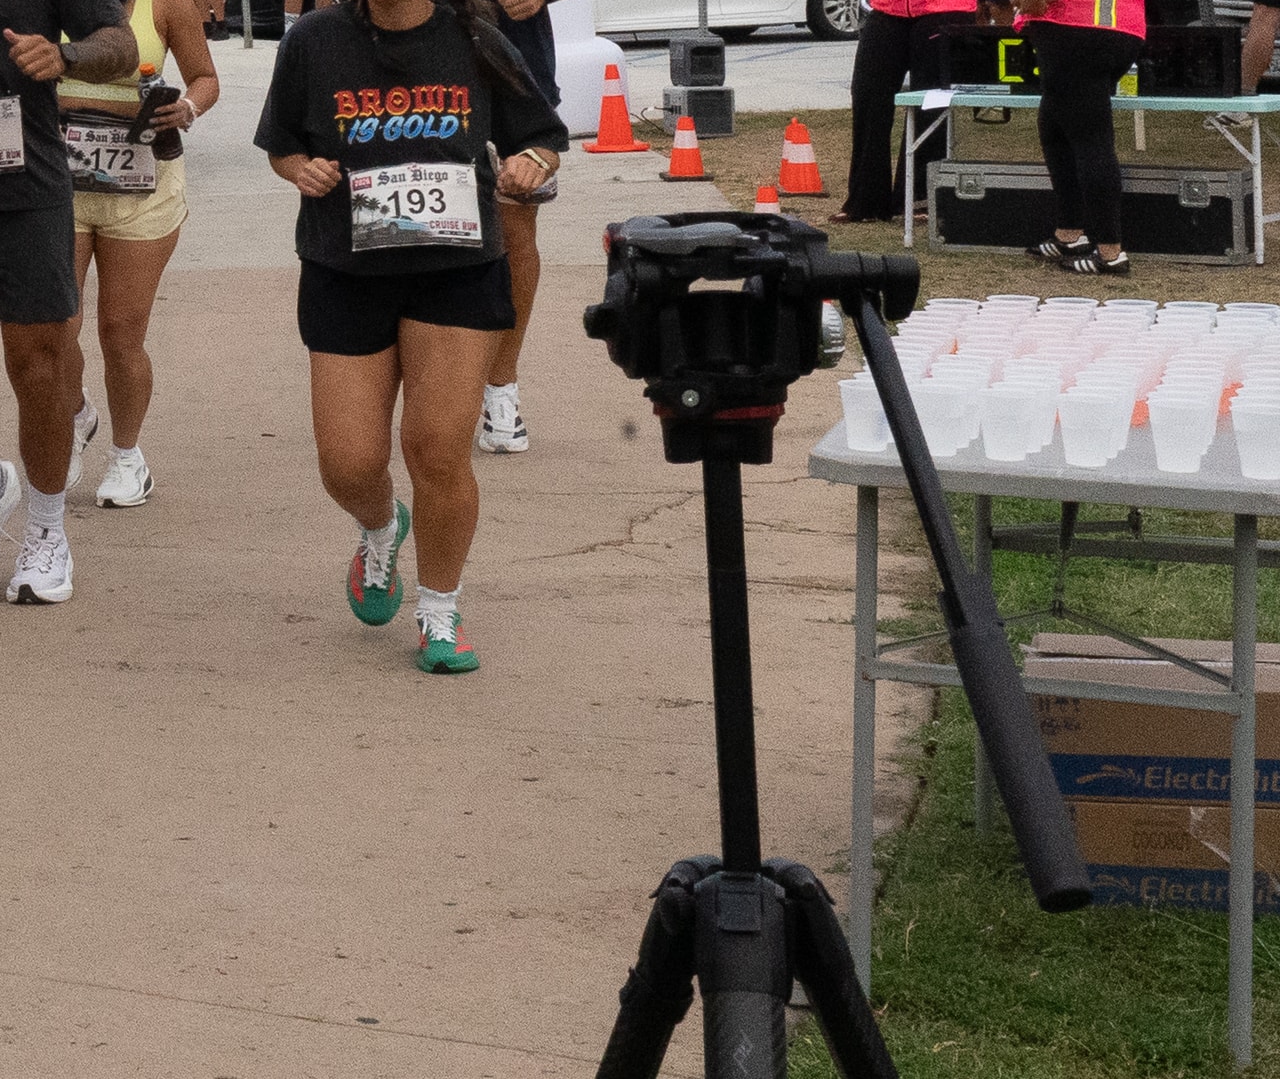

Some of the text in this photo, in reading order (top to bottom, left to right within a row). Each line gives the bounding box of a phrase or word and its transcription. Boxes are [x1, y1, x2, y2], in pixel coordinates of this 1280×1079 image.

[84, 130, 108, 142] San
[384, 114, 459, 141] GOLD
[6, 150, 21, 159] RUN
[90, 148, 134, 171] 172
[377, 171, 406, 187] San
[410, 169, 449, 182] Diego
[387, 188, 447, 219] 193
[429, 219, 478, 231] CRUISE RUN
[1143, 766, 1280, 793] Electrlit
